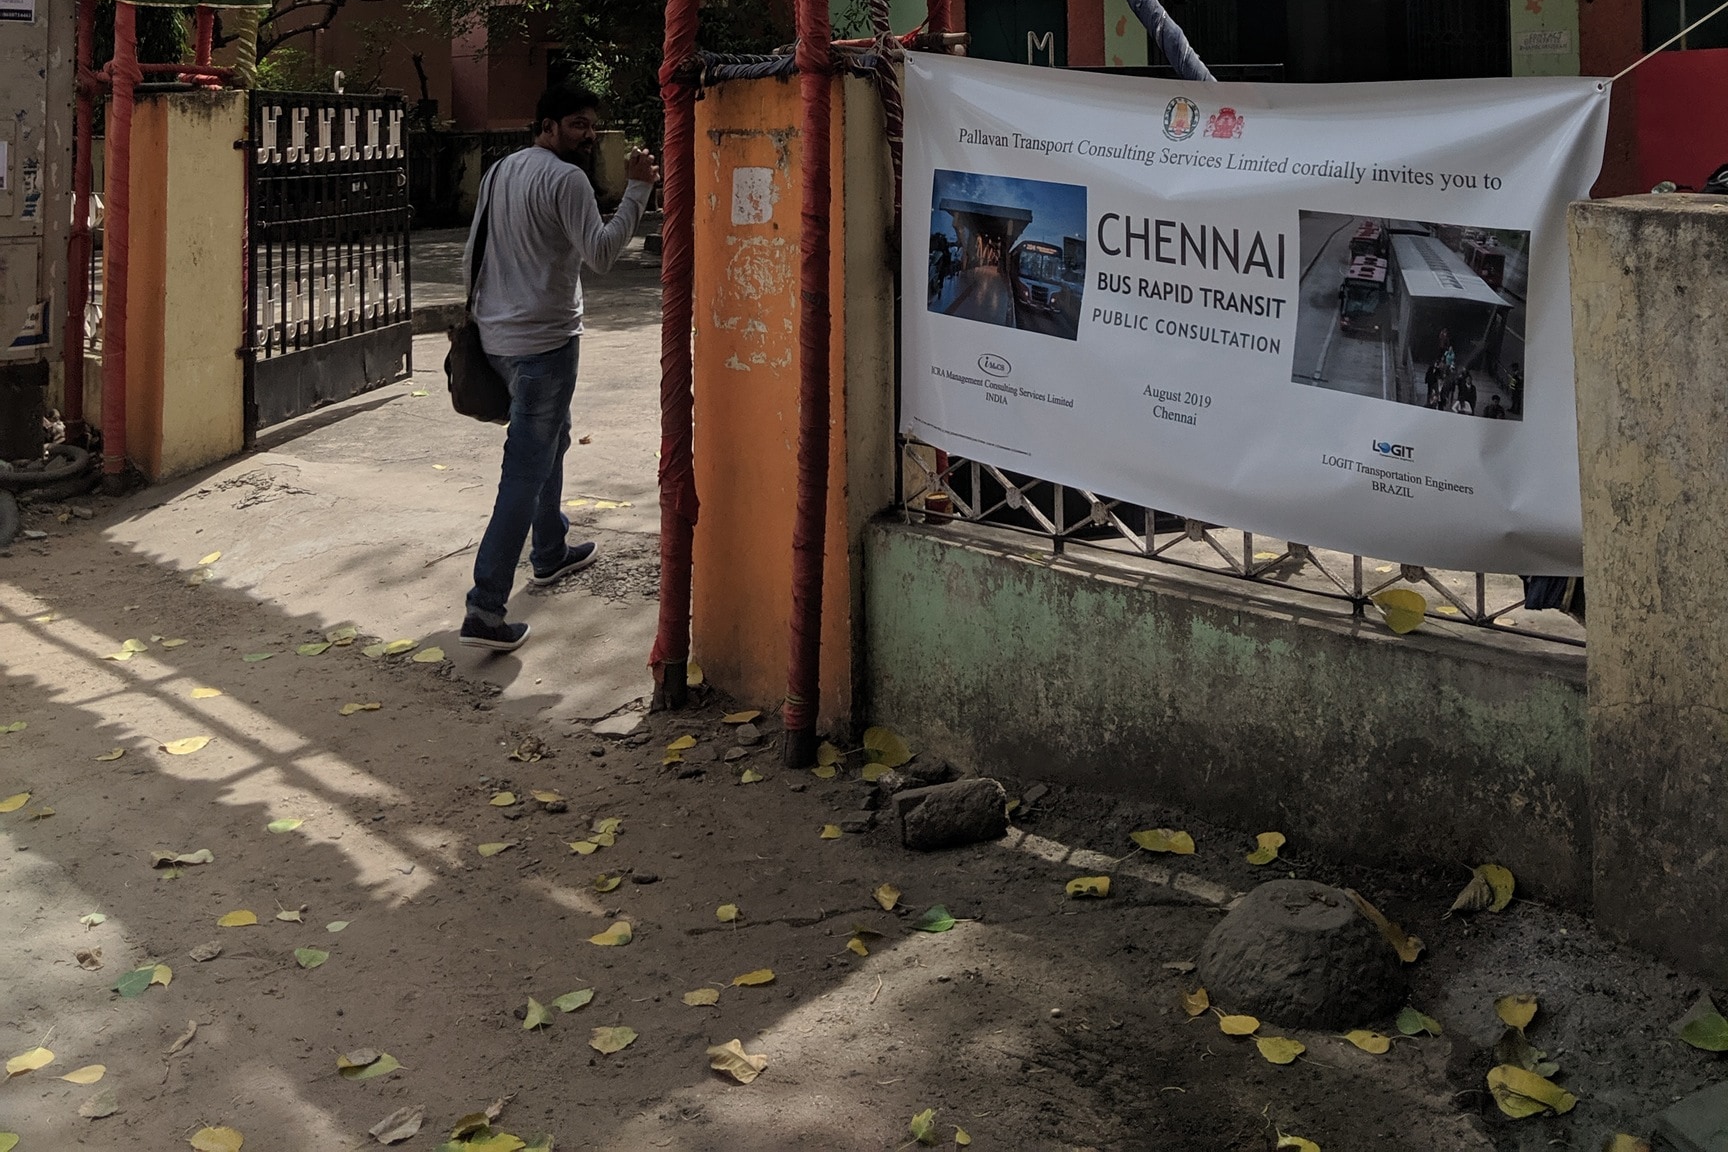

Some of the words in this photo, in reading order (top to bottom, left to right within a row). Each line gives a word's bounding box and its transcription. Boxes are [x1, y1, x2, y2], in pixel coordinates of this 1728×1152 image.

[958, 128, 1008, 148] Pallavan
[1012, 133, 1073, 155] Transport
[1077, 139, 1156, 166] Consulting
[1159, 148, 1222, 169] Services
[1226, 153, 1289, 174] Limited
[1292, 157, 1366, 184] cordially
[1372, 163, 1434, 186] invites
[1440, 172, 1477, 191] you
[1483, 173, 1502, 190] to
[1097, 212, 1285, 279] CHENNAI
[1097, 272, 1131, 294] BUS
[1138, 278, 1193, 304] RAPID
[1199, 287, 1286, 318] TRANSIT
[1092, 308, 1148, 330] PUBLIC
[1155, 319, 1281, 354] CONSULTATION
[931, 365, 945, 378] ICRA
[945, 370, 983, 387] Management
[984, 379, 1018, 396] Consulting
[1019, 387, 1046, 402] Services
[1047, 393, 1074, 408] Limited
[985, 392, 1008, 405] INDIA
[1143, 384, 1181, 402] August
[1184, 391, 1212, 408] 2019
[1152, 405, 1197, 426] Chennai
[1322, 454, 1354, 470] LOGIT
[1356, 462, 1422, 485] Transportation
[1425, 475, 1474, 495] Engineers
[1372, 480, 1414, 498] BRAZIL
